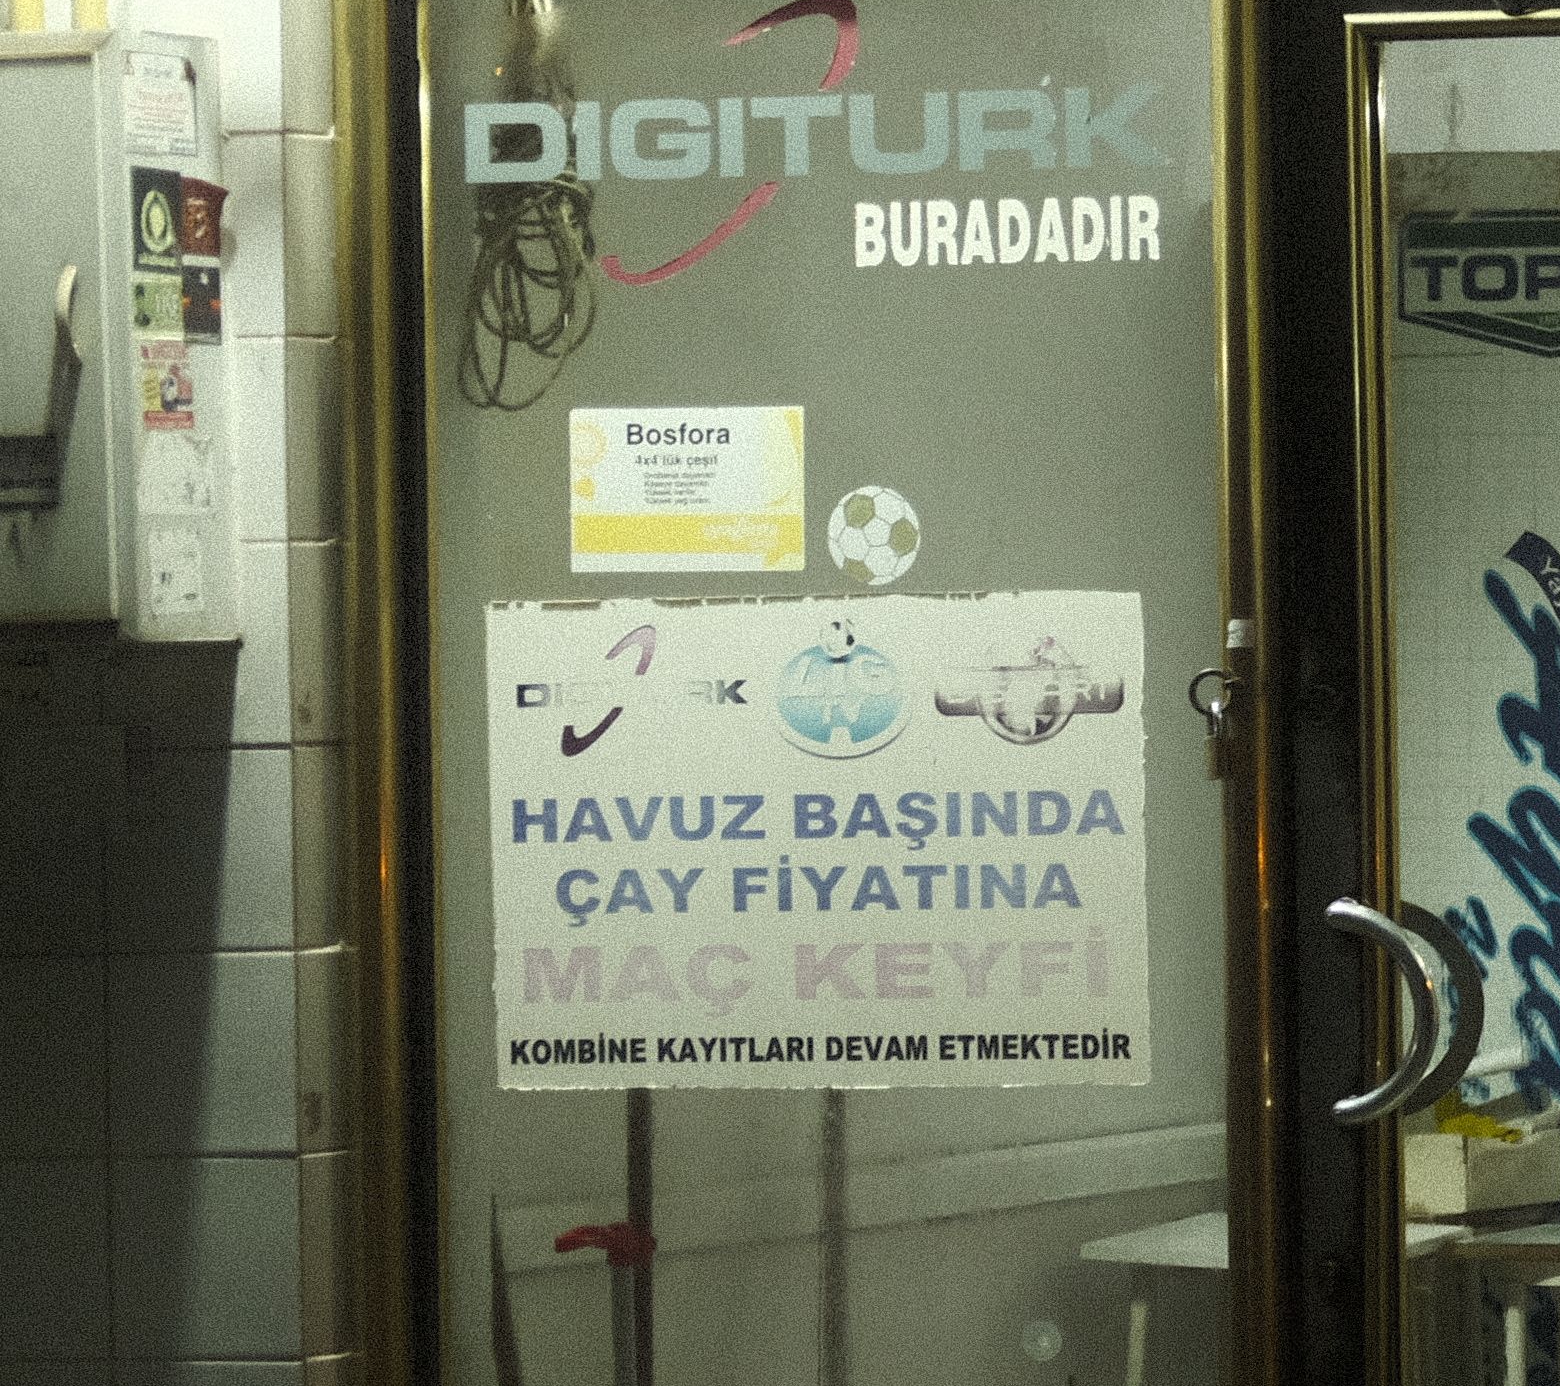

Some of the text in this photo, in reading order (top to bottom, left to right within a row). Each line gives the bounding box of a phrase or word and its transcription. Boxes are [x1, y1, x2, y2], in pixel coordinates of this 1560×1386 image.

[463, 80, 1167, 185] DIGITURK
[855, 195, 1162, 268] BURADADIR
[626, 422, 730, 446] Bosfora
[511, 789, 1126, 851] HAVUZ BAŞINDA
[553, 854, 1083, 928] ÇAY FİYATINA
[521, 931, 1109, 1015] MAÇ KEYFİ
[509, 1027, 1131, 1066] KOMBİNE KAYITLARI DEVAM ETMEKTEDİR
